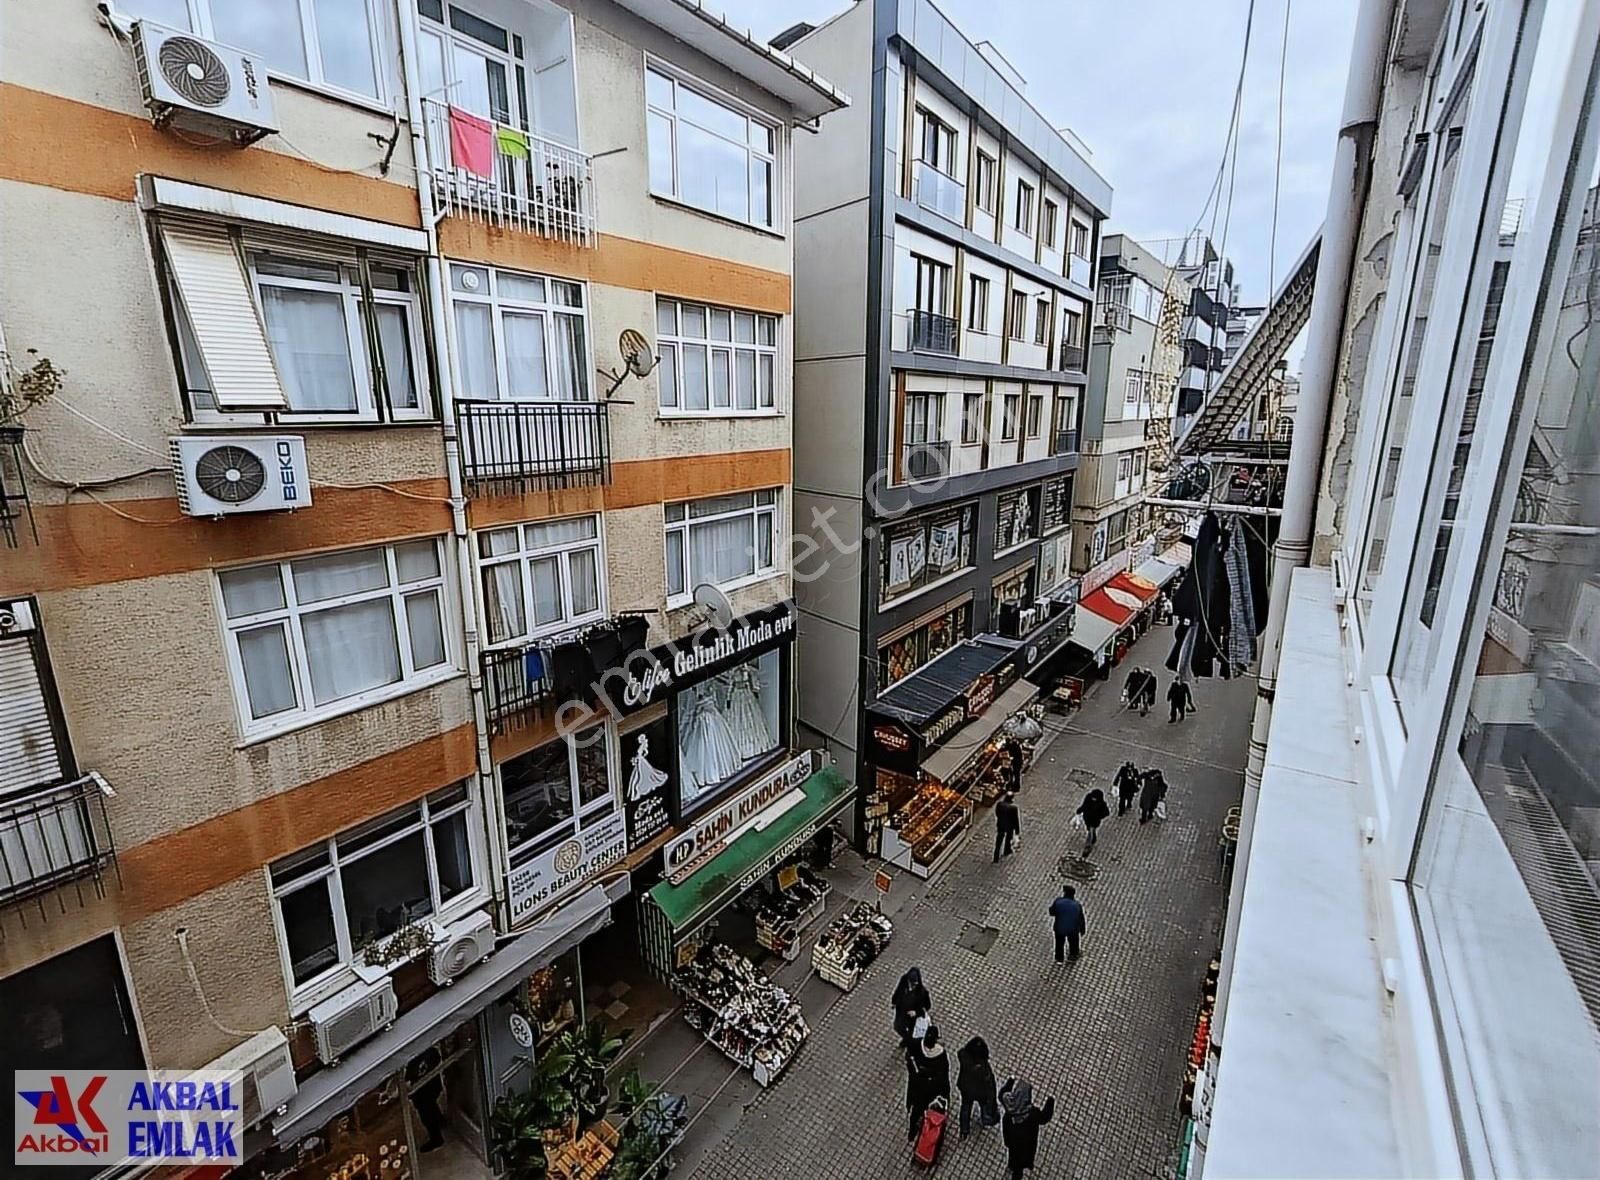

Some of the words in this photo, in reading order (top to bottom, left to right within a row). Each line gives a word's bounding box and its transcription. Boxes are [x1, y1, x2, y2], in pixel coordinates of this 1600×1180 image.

[277, 441, 297, 501] BEKO
[673, 636, 735, 677] Gelinlik
[737, 620, 773, 651] Moda
[774, 610, 793, 637] evi
[738, 772, 791, 820] KUNDURA
[774, 824, 817, 863] KUNDURA
[514, 887, 549, 917] LIONS
[550, 861, 590, 893] BEAUTY
[590, 840, 625, 868] CENTER
